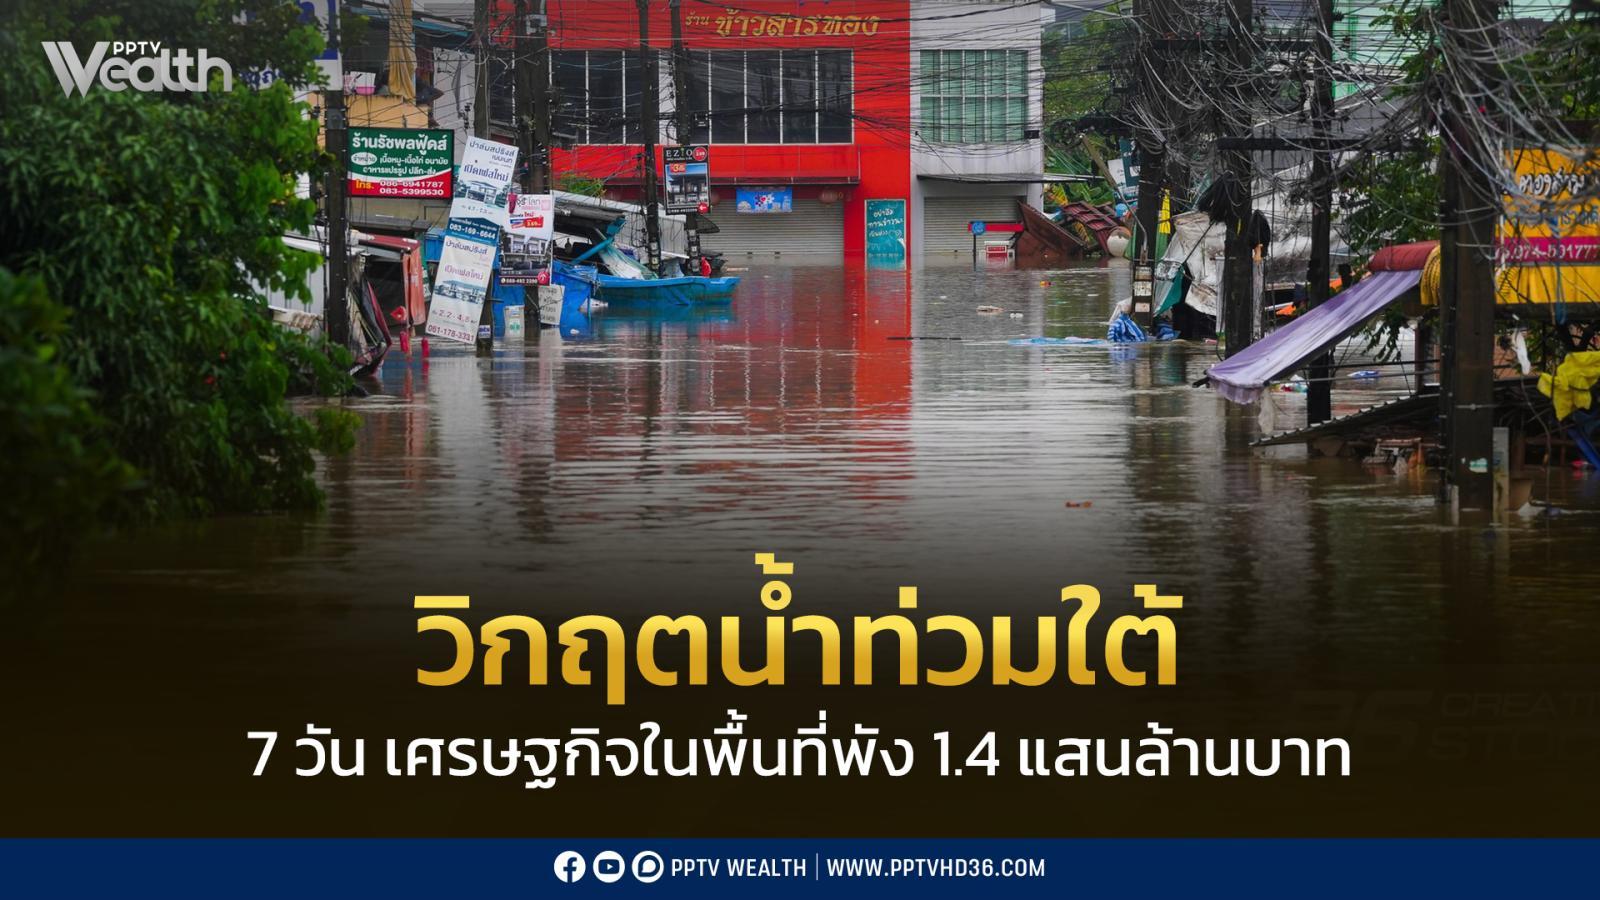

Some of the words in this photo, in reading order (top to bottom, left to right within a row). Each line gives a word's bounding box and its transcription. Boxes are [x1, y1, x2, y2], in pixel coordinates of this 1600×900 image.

[685, 12, 709, 25] ร้าน
[714, 9, 880, 37] ข้าวสารทอง
[352, 132, 447, 155] ร้านรัชพลฟู้ดส์
[425, 155, 449, 165] อนามัย
[355, 179, 374, 190] โทร.
[380, 187, 444, 195] 083-5399530
